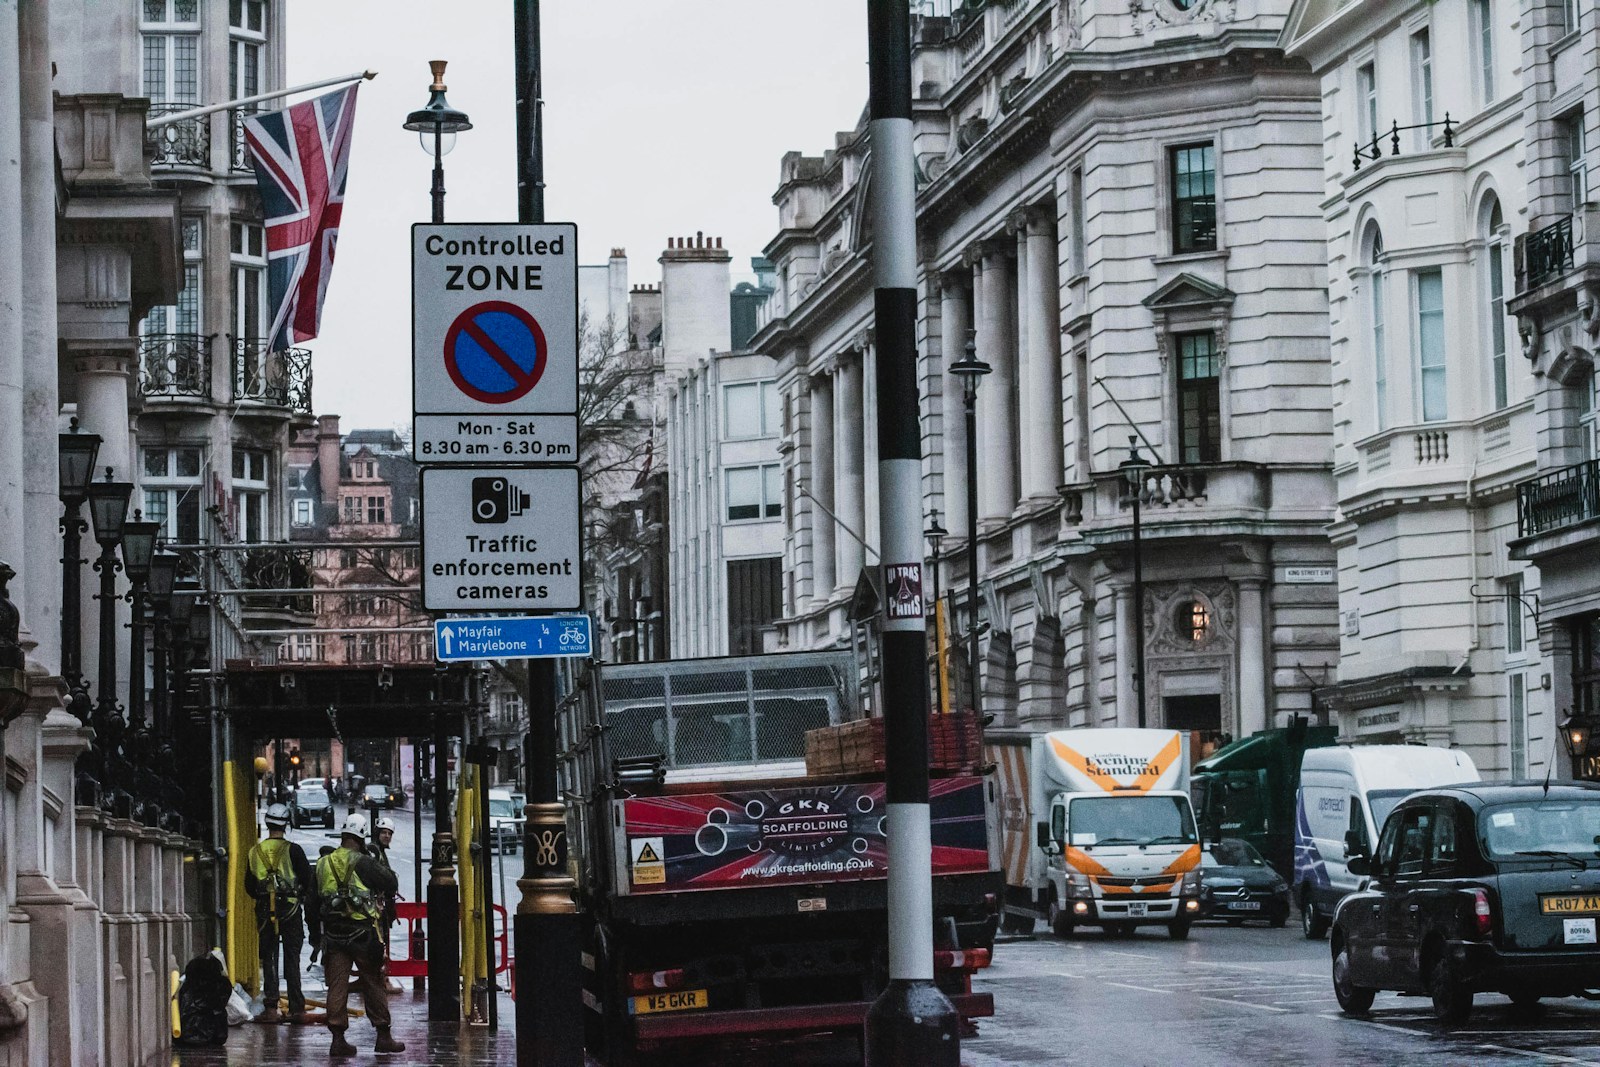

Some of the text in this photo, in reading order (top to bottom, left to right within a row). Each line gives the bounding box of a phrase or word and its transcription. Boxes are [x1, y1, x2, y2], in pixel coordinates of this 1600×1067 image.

[425, 235, 564, 256] Controlled
[445, 265, 543, 291] ZONE
[458, 422, 493, 435] Mon
[506, 422, 535, 435] Sat
[422, 441, 461, 454] 8.30
[465, 444, 489, 454] am
[503, 441, 542, 454] 6.30
[546, 444, 571, 457] pm
[466, 535, 537, 552] Traffic
[432, 558, 572, 576] enforcement
[456, 585, 548, 599] cameras
[458, 626, 502, 639] Mayfair
[459, 638, 543, 653] Marylebone 1
[1085, 755, 1150, 768] Evening
[1086, 765, 1159, 776] Standard
[779, 800, 830, 814] GKR
[762, 820, 848, 834] SCAFFOLDING
[781, 837, 833, 851] LIMITED
[743, 859, 874, 877] www.gkrscaffolding.co.uk
[1547, 897, 1600, 910] LR07 XA
[648, 993, 696, 1010] W5 GKR
